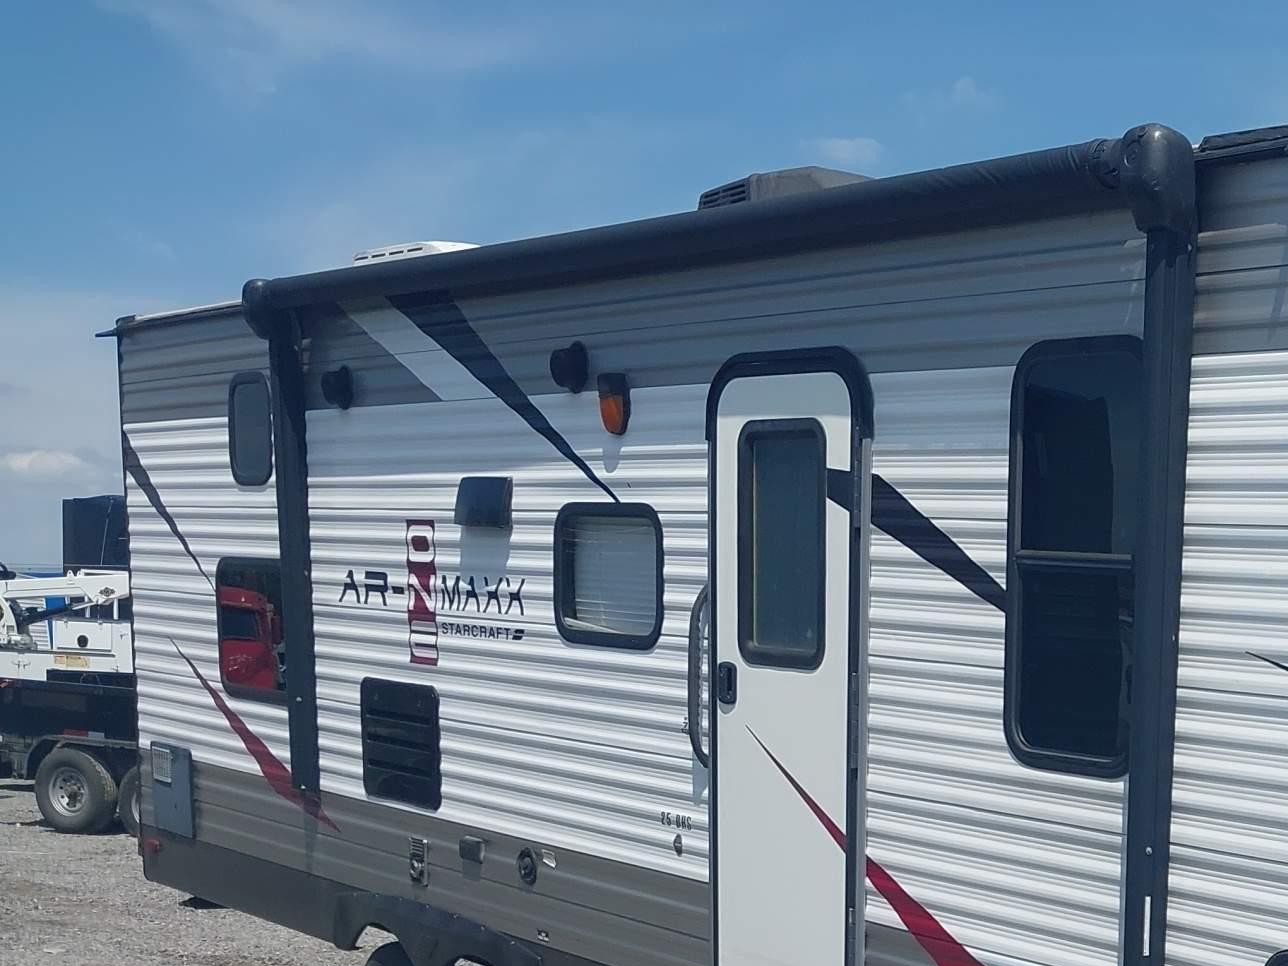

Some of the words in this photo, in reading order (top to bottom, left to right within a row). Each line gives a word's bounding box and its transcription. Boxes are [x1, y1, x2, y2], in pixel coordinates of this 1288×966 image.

[441, 574, 525, 616] MAXX
[441, 622, 511, 641] STARCRAFT
[661, 811, 671, 826] 25
